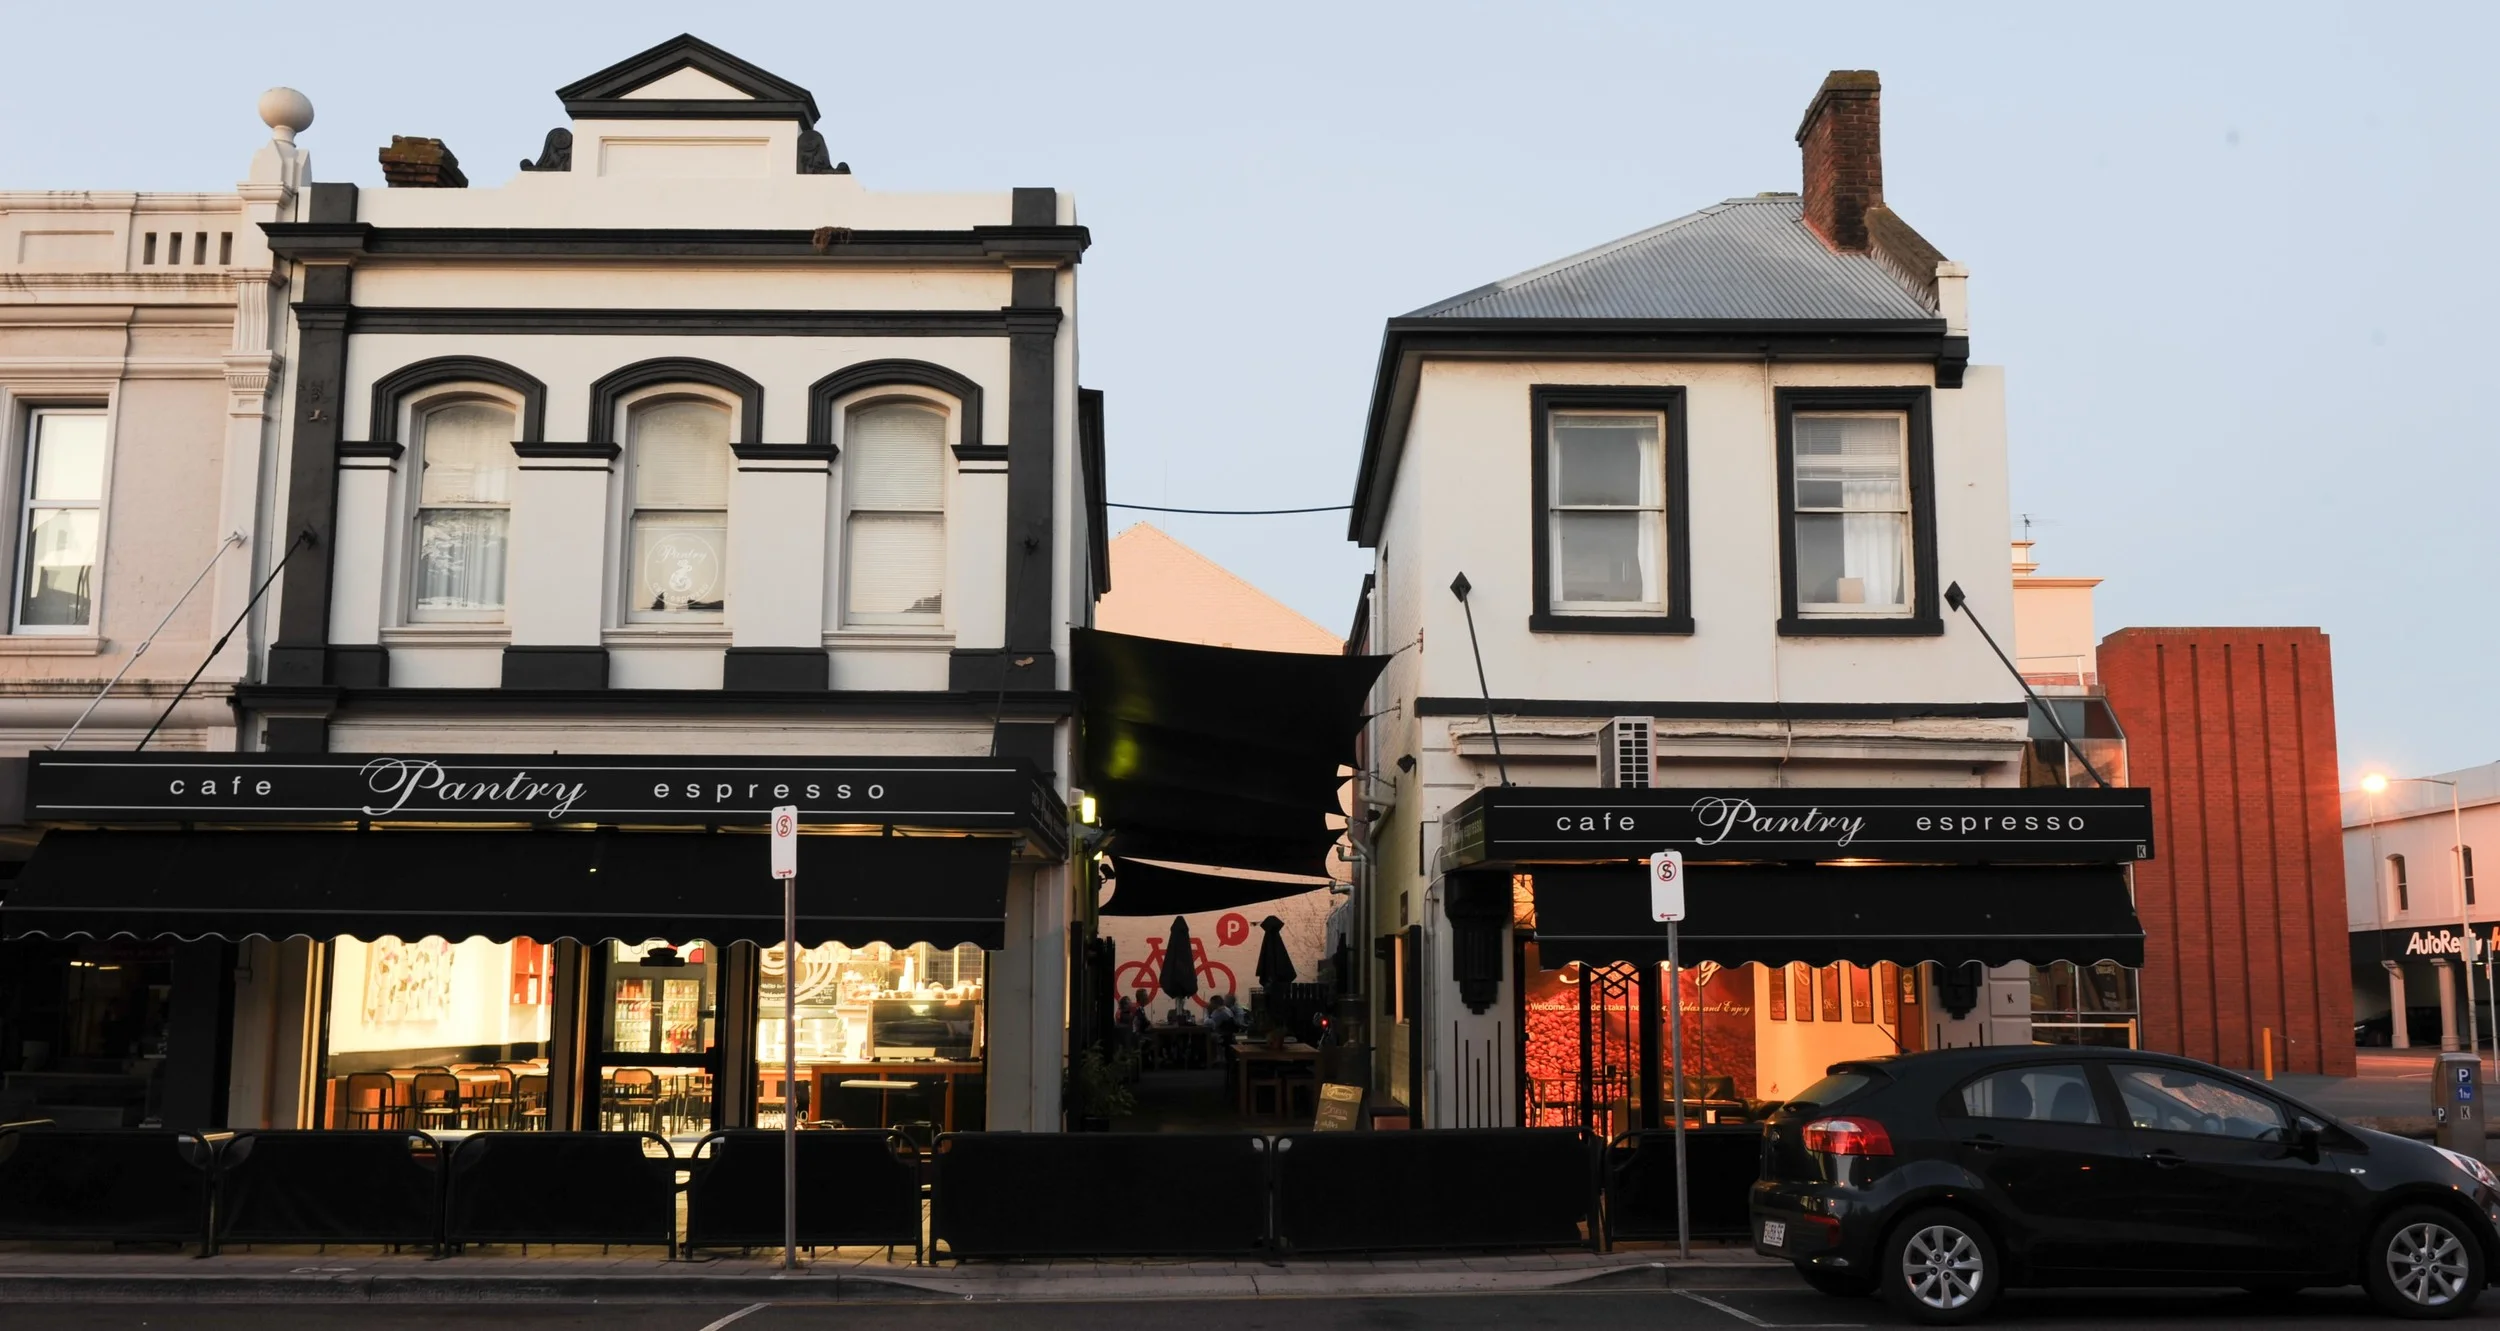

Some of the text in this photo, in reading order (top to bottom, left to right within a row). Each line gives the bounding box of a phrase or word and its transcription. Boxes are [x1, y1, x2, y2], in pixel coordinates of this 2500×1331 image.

[655, 544, 708, 564] Pantry
[169, 757, 885, 819] cafe Pantry espresso
[1556, 796, 2084, 847] cafe Pantry espresso
[1226, 919, 1241, 938] P
[2405, 928, 2483, 955] AutoRe
[1703, 1002, 1722, 1012] and
[1723, 1000, 1751, 1017] Enjoy
[2458, 1068, 2469, 1082] P
[2437, 1107, 2445, 1121] P
